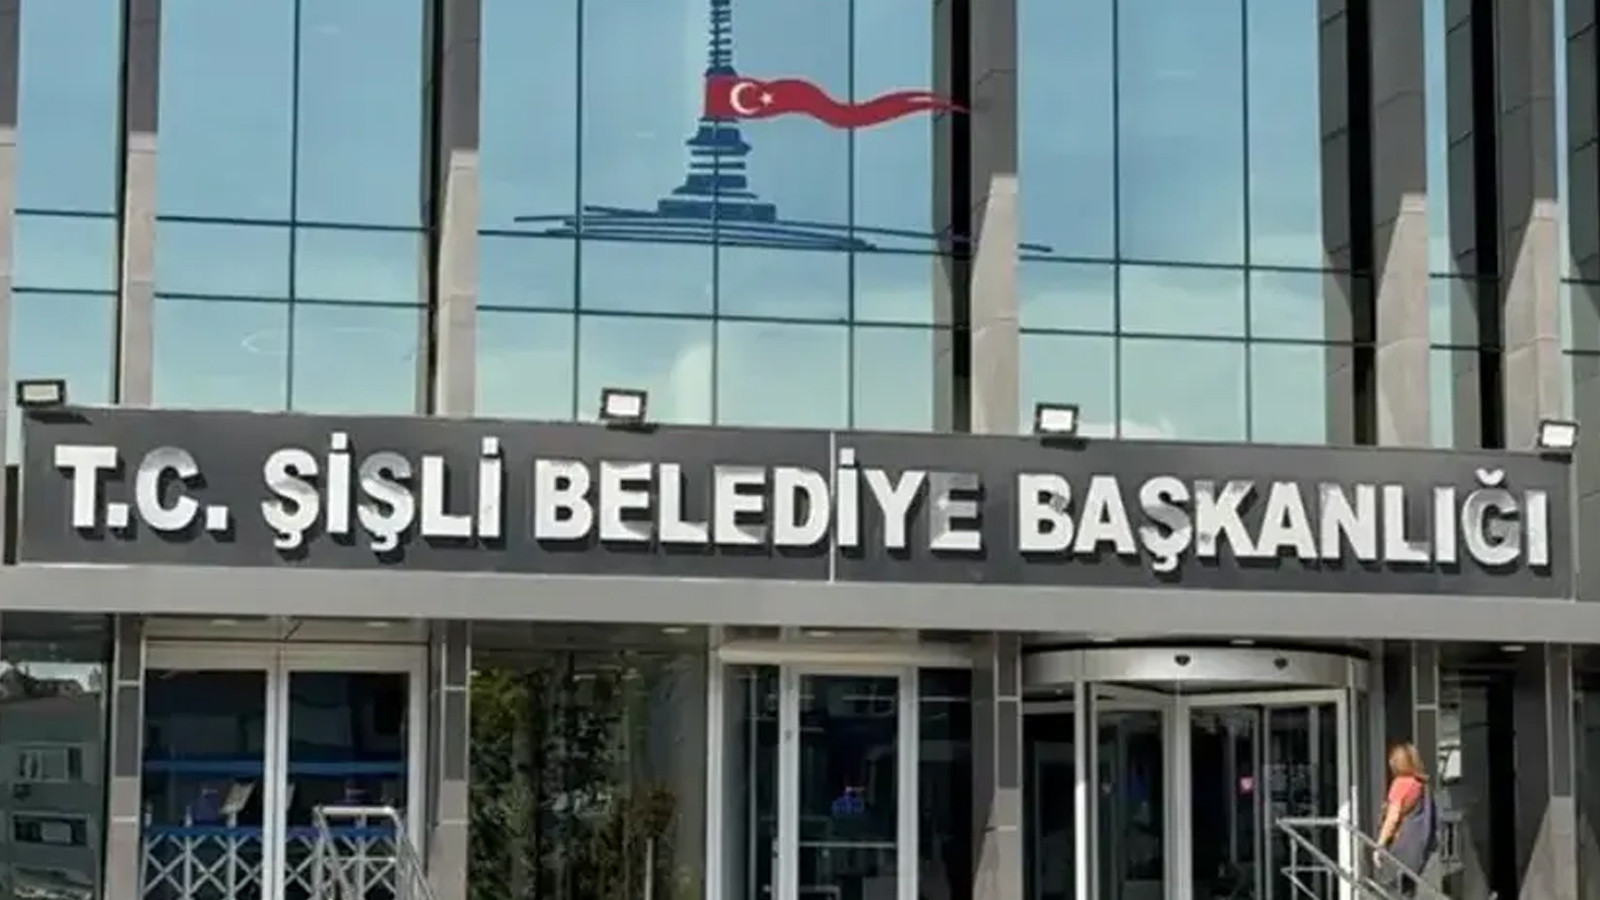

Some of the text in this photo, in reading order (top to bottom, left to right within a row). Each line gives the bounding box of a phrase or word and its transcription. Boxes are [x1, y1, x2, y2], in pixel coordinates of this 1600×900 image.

[55, 432, 1548, 571] T.C. ŞİŞLİ BELEDİYE BAŞKANLIĞI
